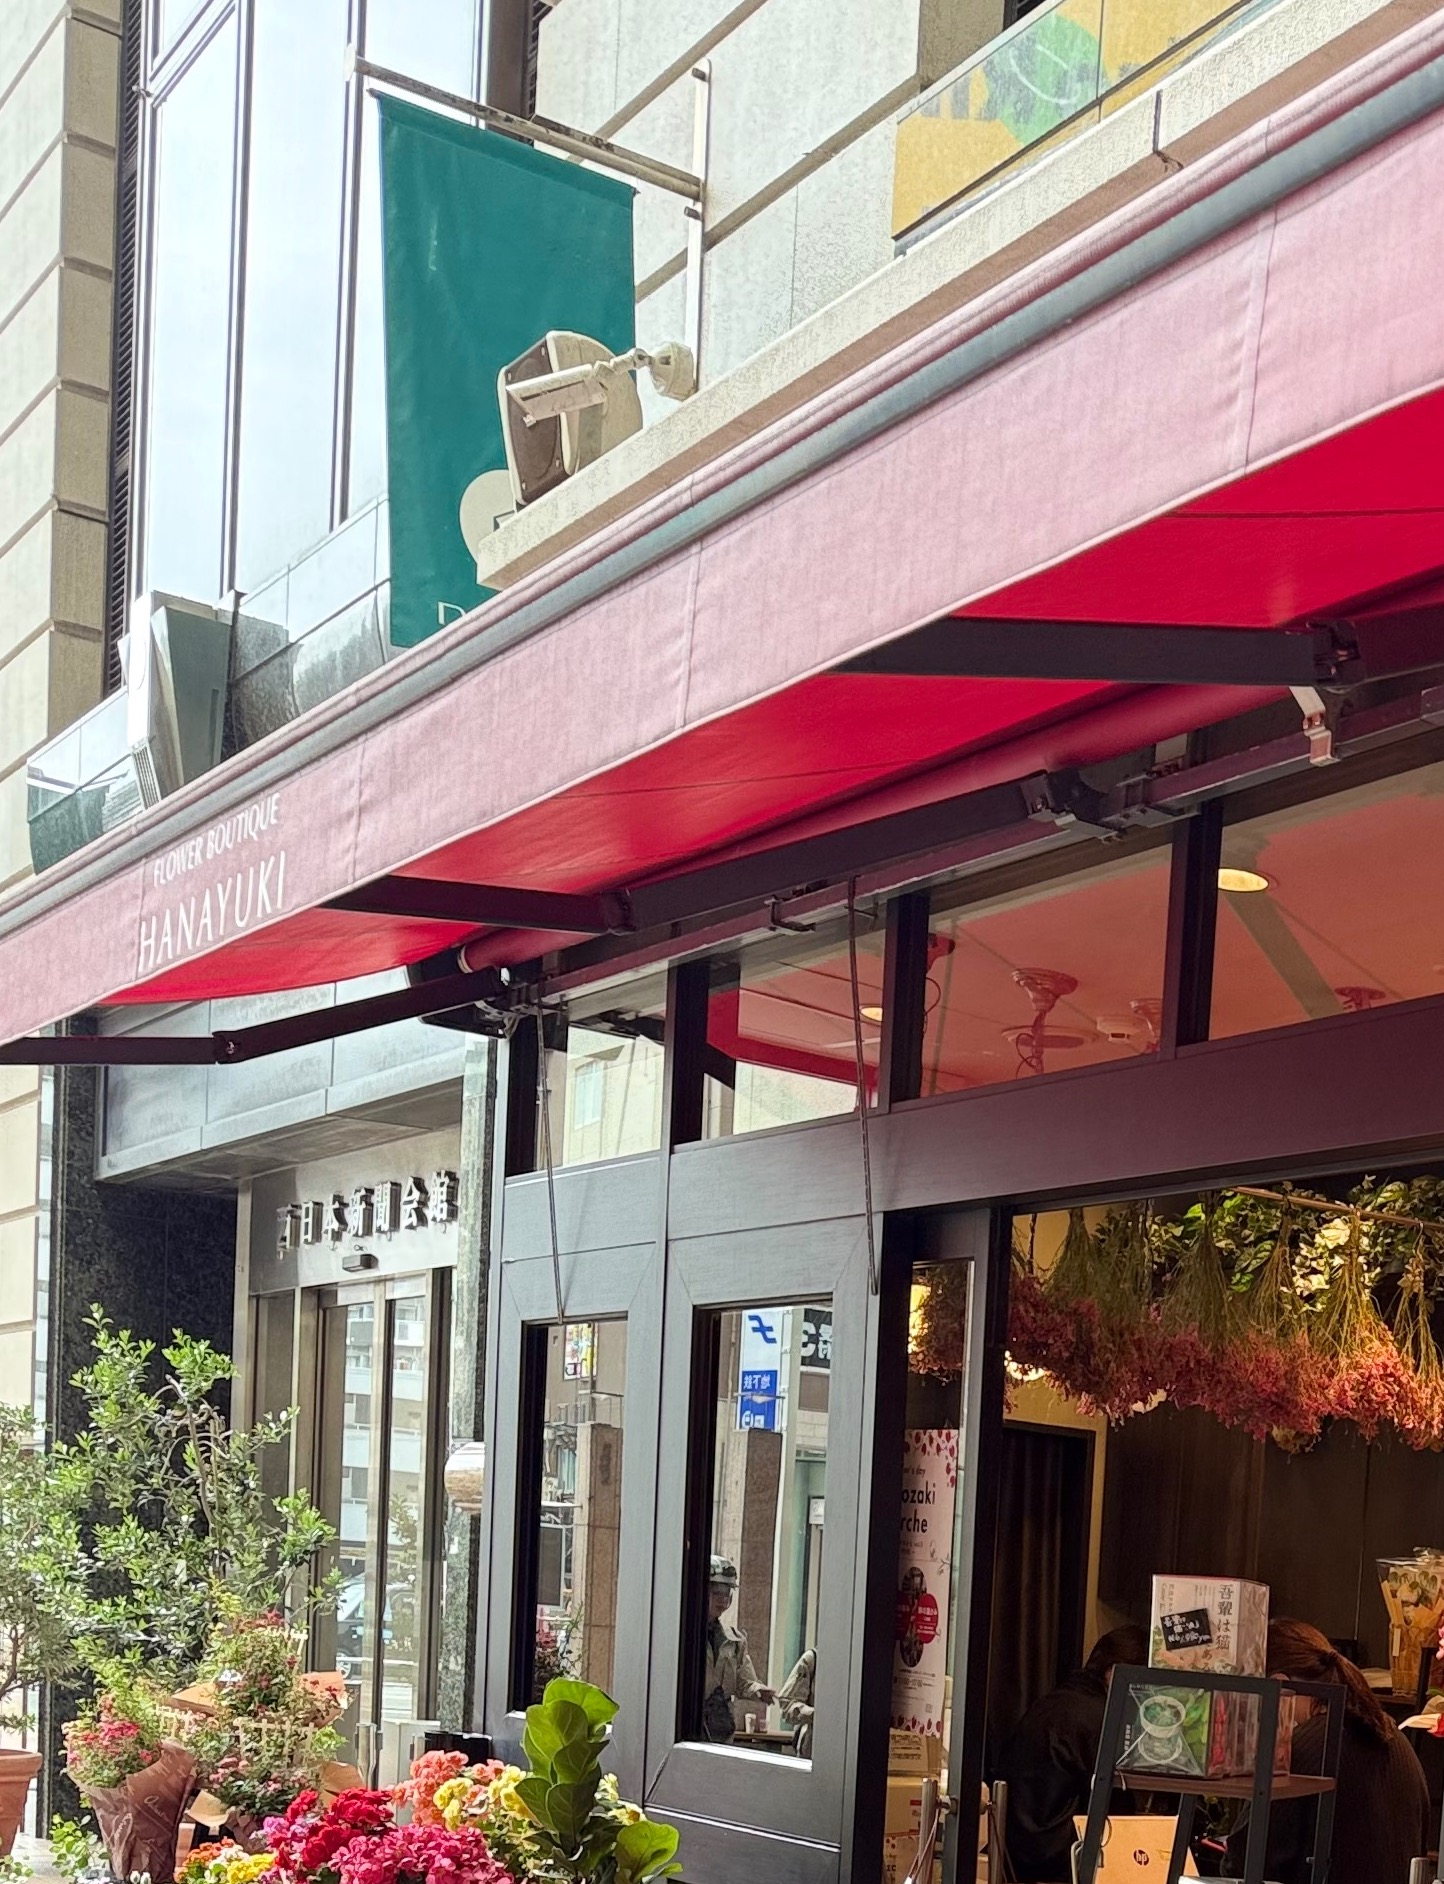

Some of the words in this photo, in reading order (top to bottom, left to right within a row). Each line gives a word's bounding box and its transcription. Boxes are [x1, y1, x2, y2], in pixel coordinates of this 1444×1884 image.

[154, 836, 204, 889] FLOWER
[206, 792, 281, 861] BOUTIQUE
[138, 850, 286, 972] HANAYUKI
[902, 1480, 936, 1505] ozaki
[901, 1509, 928, 1533] rche
[1134, 1850, 1149, 1866] hp
